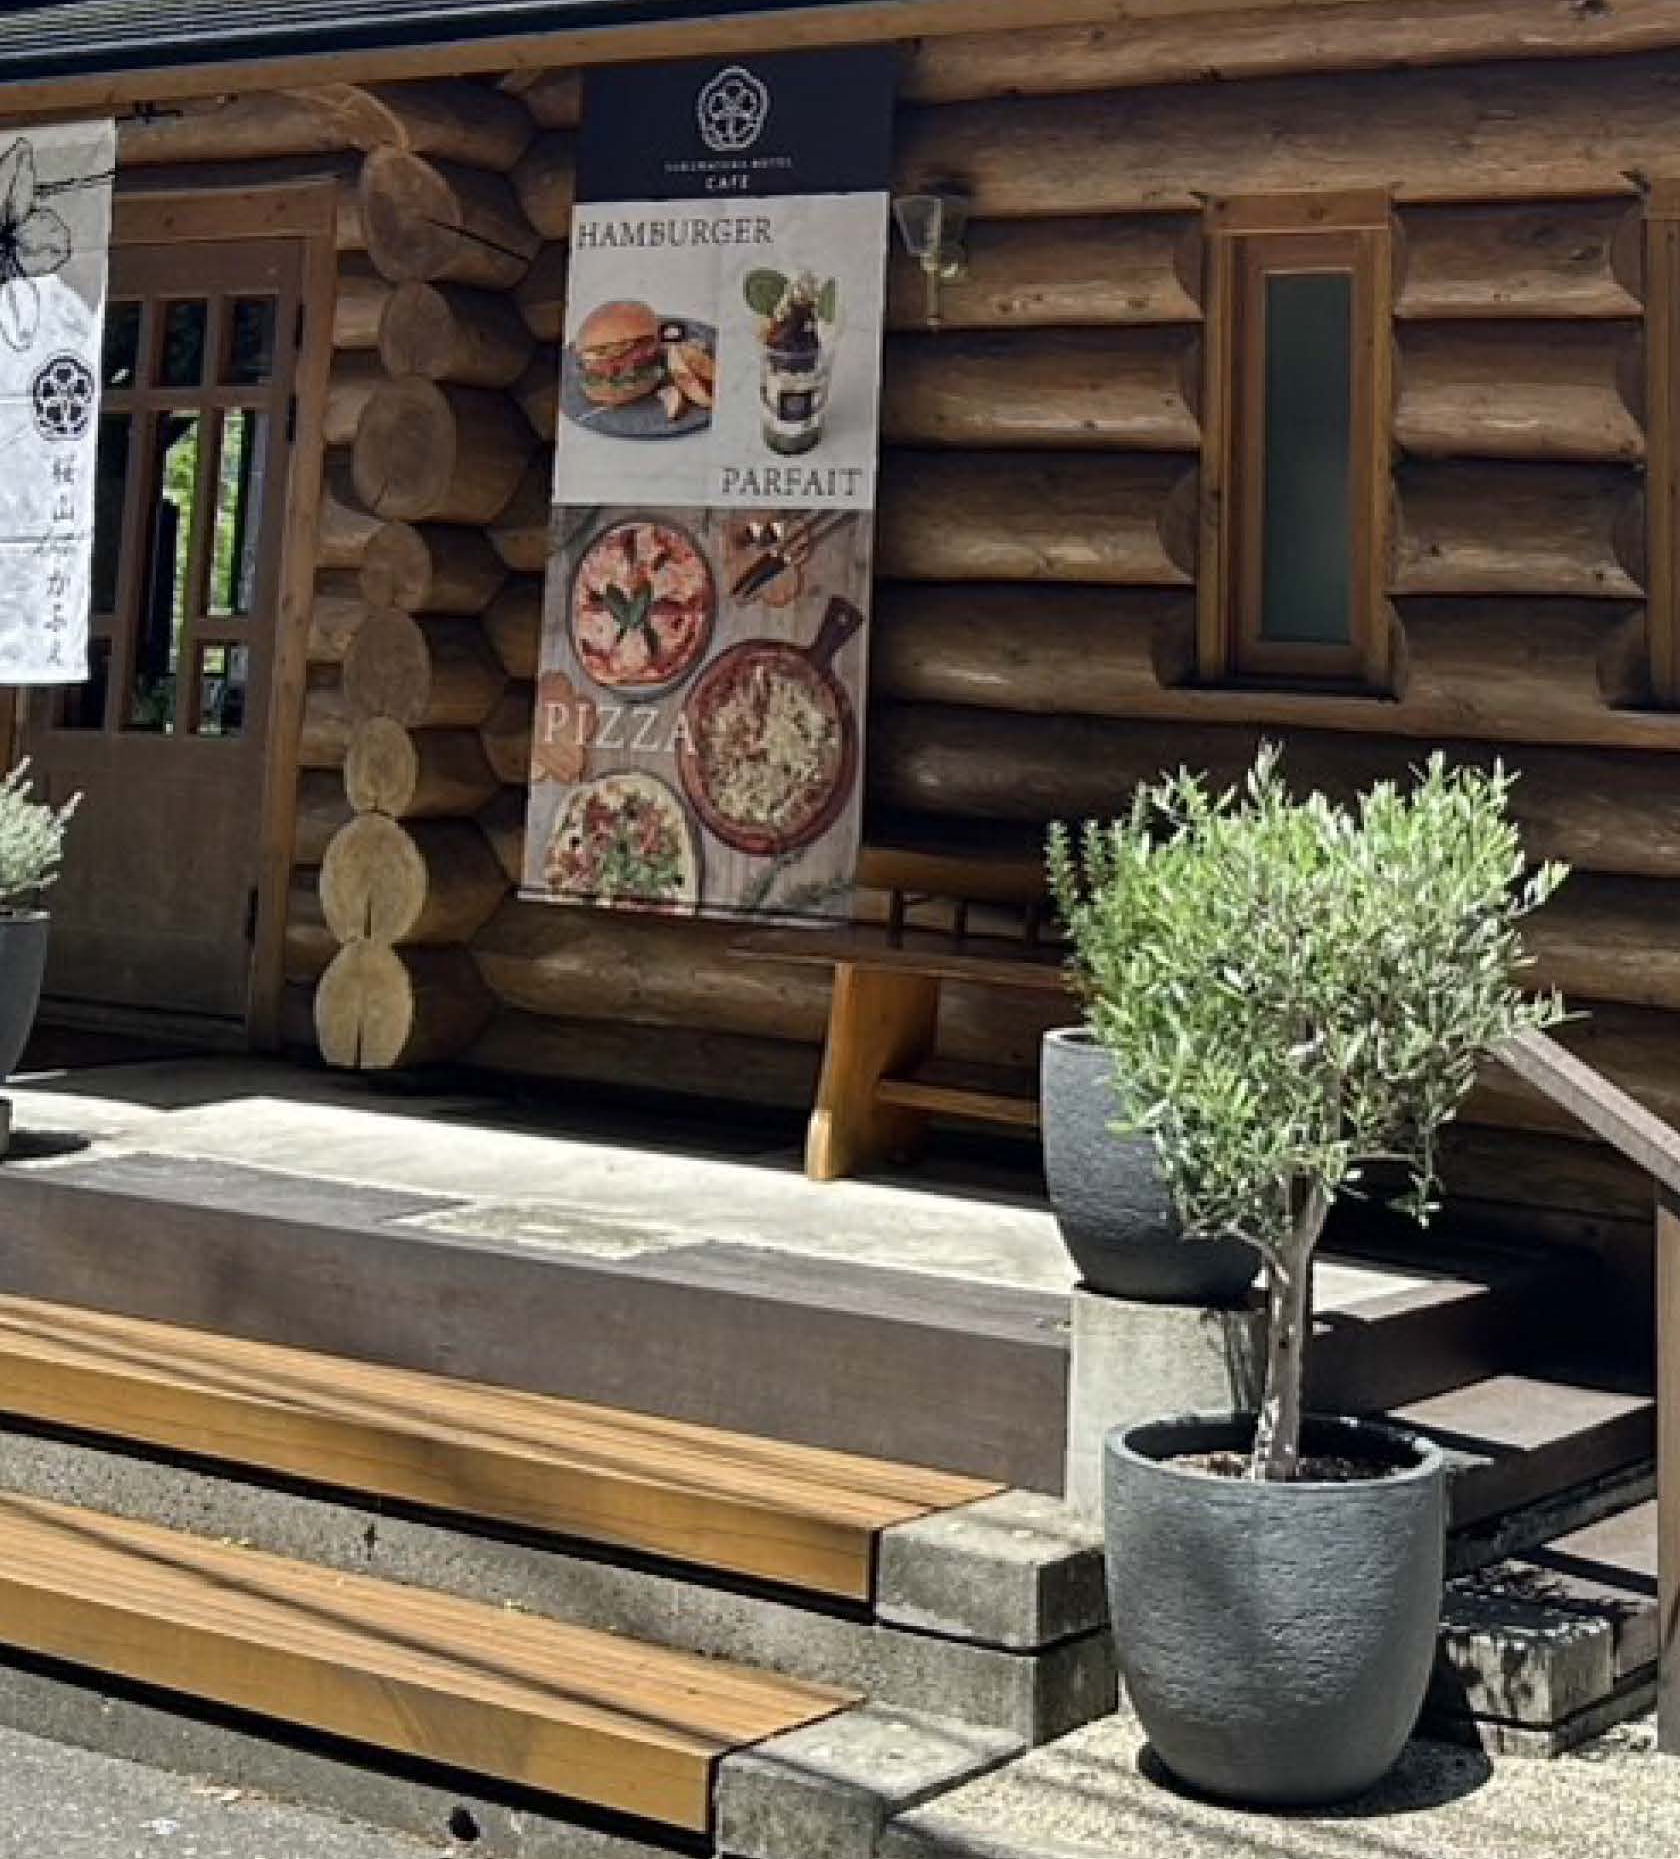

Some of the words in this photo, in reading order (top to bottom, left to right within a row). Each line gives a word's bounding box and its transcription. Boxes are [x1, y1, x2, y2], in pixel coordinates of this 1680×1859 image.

[704, 174, 750, 190] CAFE
[577, 215, 773, 250] HAMBURGER
[721, 467, 864, 497] PARFAIT
[542, 702, 699, 755] PIZZA
